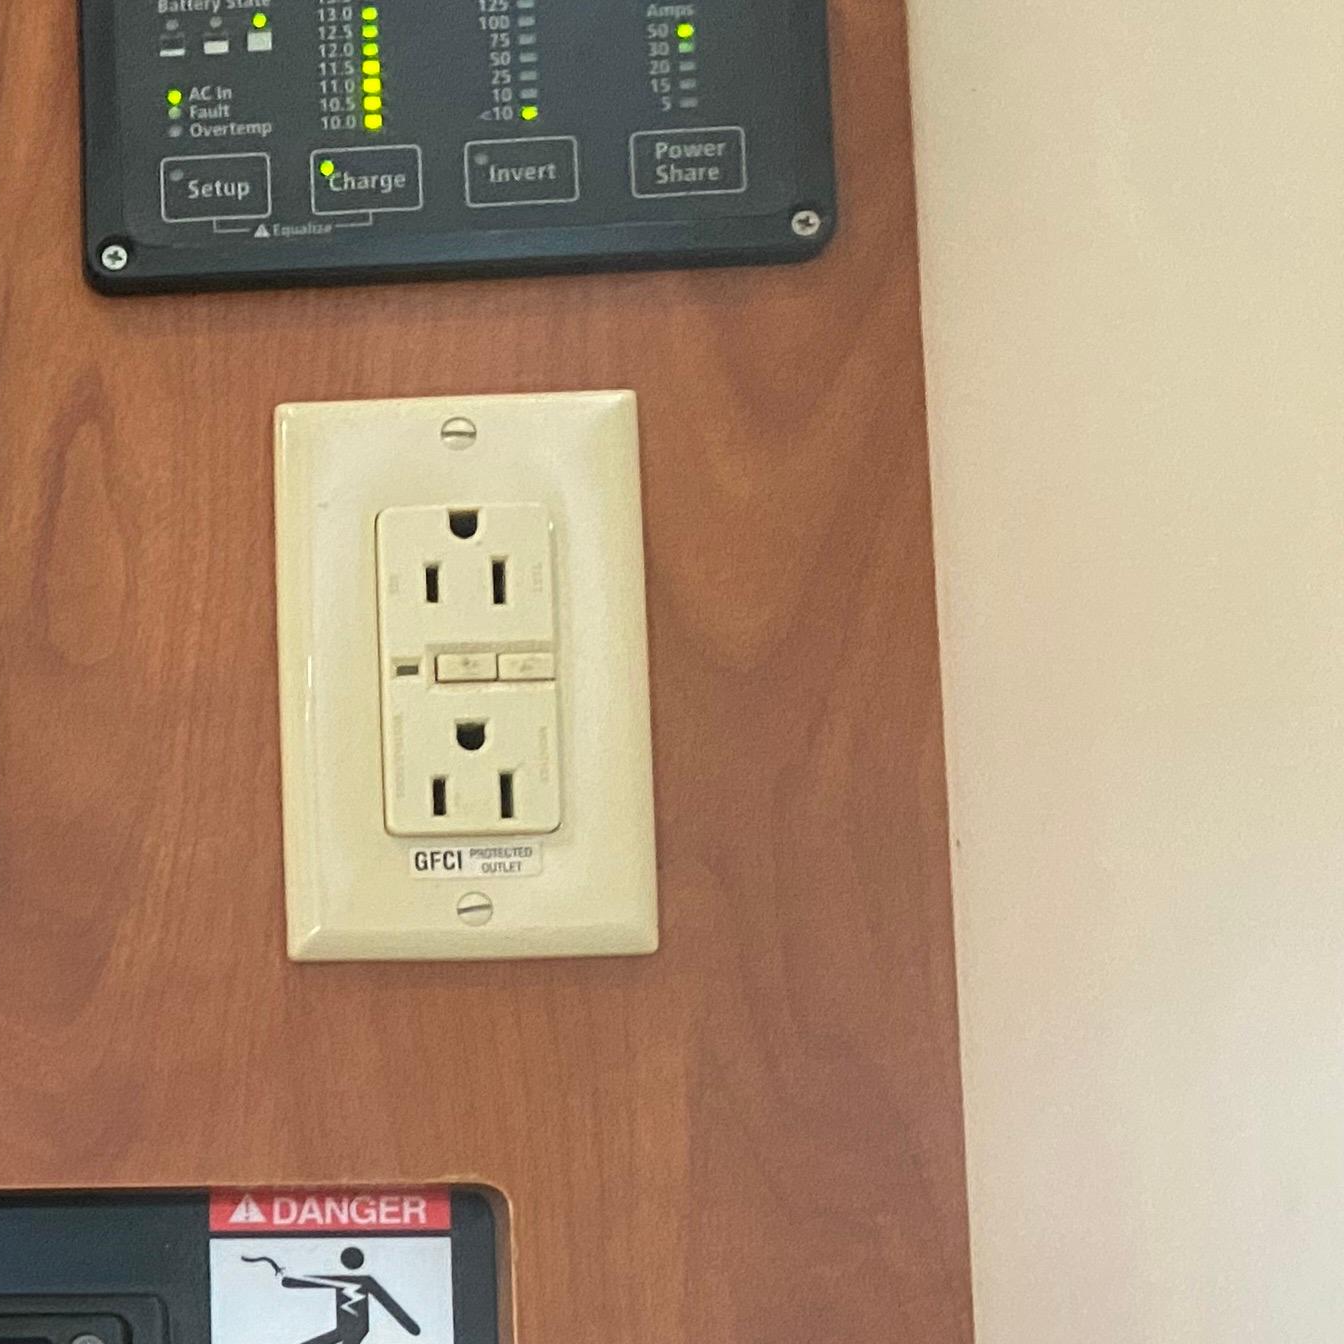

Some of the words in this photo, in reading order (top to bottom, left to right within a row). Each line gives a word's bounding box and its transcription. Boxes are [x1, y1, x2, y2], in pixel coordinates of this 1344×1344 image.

[318, 8, 353, 21] 13.0
[647, 4, 695, 19] Amps
[318, 26, 353, 39] 12.5
[318, 44, 354, 57] 12.0
[318, 62, 354, 75] 11.5
[320, 80, 355, 93] 11.0
[189, 87, 212, 101] AC
[189, 105, 230, 119] Fault
[320, 99, 356, 111] 10.5
[321, 117, 356, 129] 10.0
[189, 123, 272, 139] Overtemp
[655, 140, 725, 160] Power
[490, 162, 556, 183] Invert
[656, 163, 720, 185] Share
[328, 172, 407, 193] Charge
[188, 180, 250, 200] Setup
[272, 222, 333, 237] Equalize
[414, 850, 463, 872] GFCI
[469, 847, 533, 860] PROTECTED
[481, 861, 523, 874] OUTLET
[273, 1197, 428, 1226] DANGER
